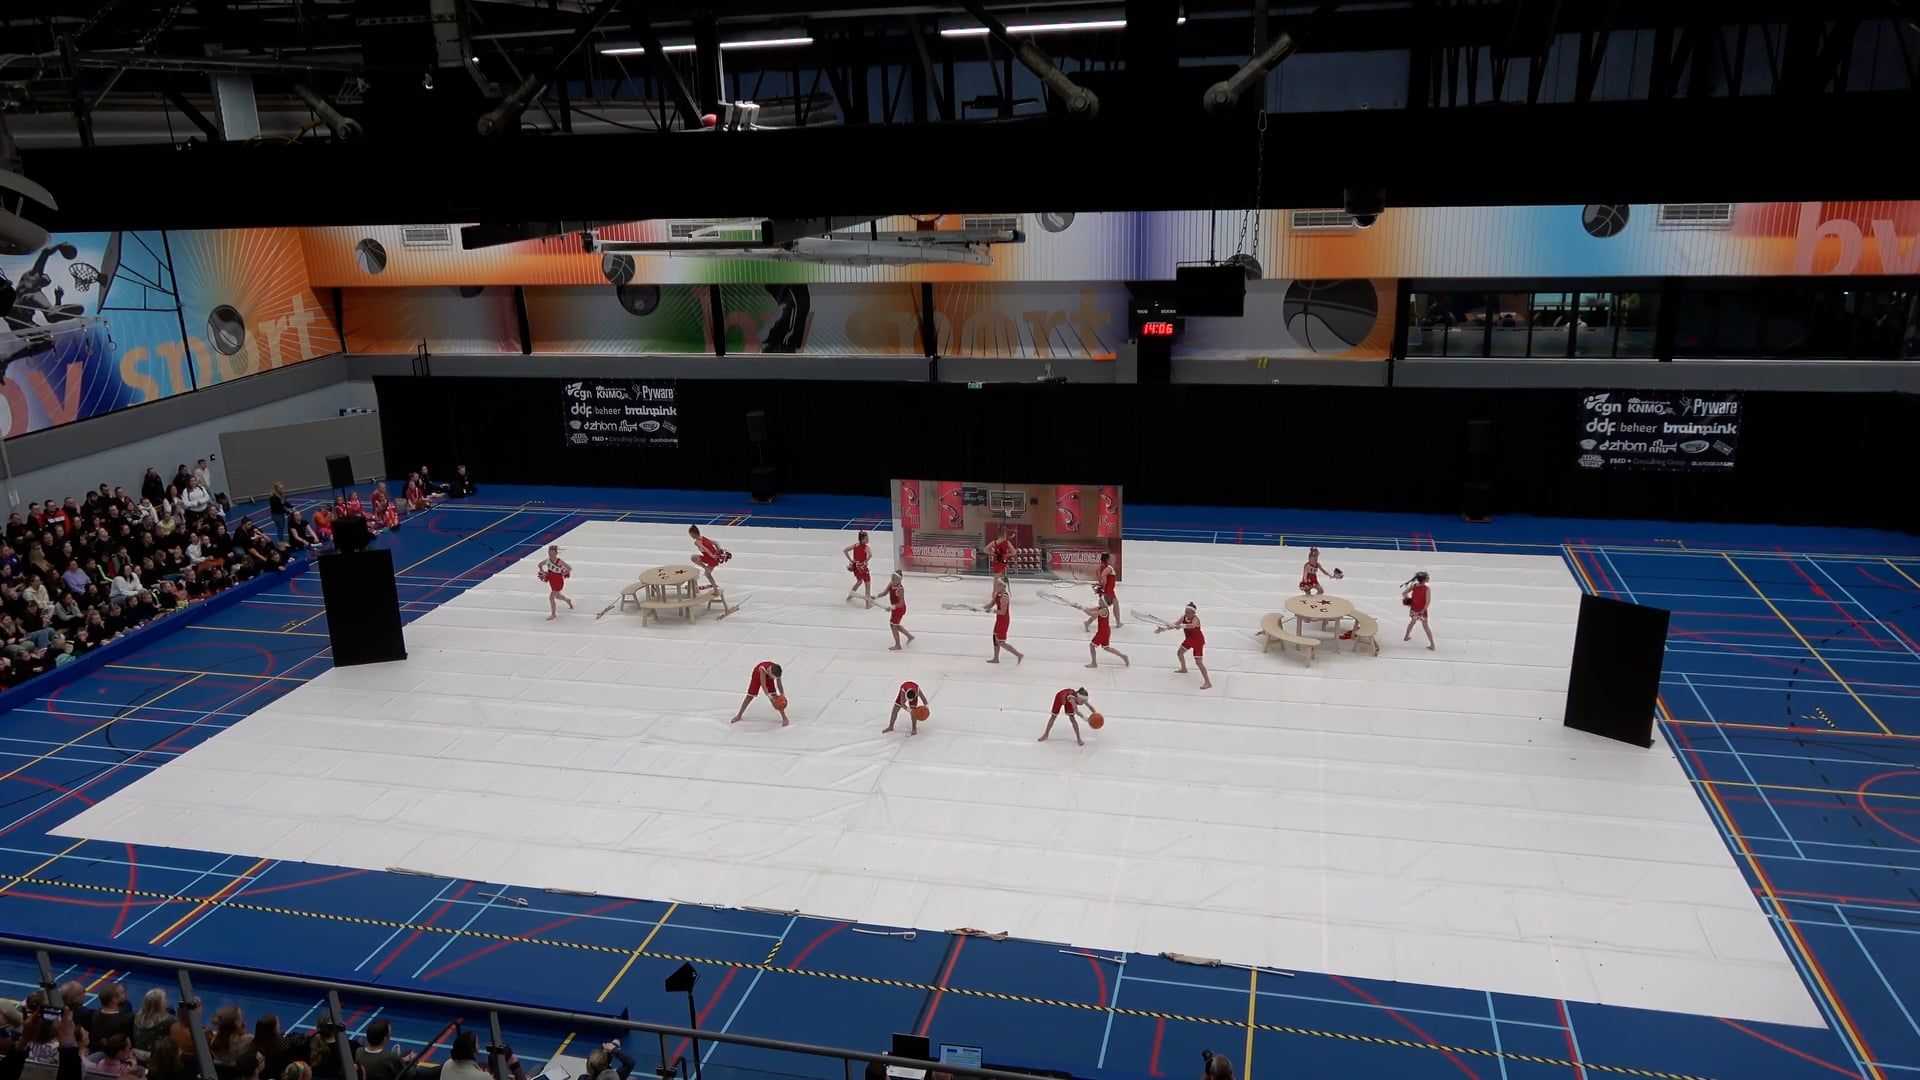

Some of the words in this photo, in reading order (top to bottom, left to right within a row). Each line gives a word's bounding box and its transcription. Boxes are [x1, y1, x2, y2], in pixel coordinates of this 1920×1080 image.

[1144, 323, 1173, 335] 14:06
[597, 390, 623, 399] KNMO
[642, 385, 674, 400] Pyware
[571, 402, 592, 418] ddf
[595, 406, 621, 415] beheer
[625, 405, 677, 417] brainpink
[1595, 403, 1621, 415] cgn
[1628, 403, 1664, 413] KNMO
[1693, 398, 1738, 416] Pyware
[1586, 418, 1617, 436] ddf
[1620, 422, 1658, 433] beheer
[1664, 422, 1738, 436] brainpink
